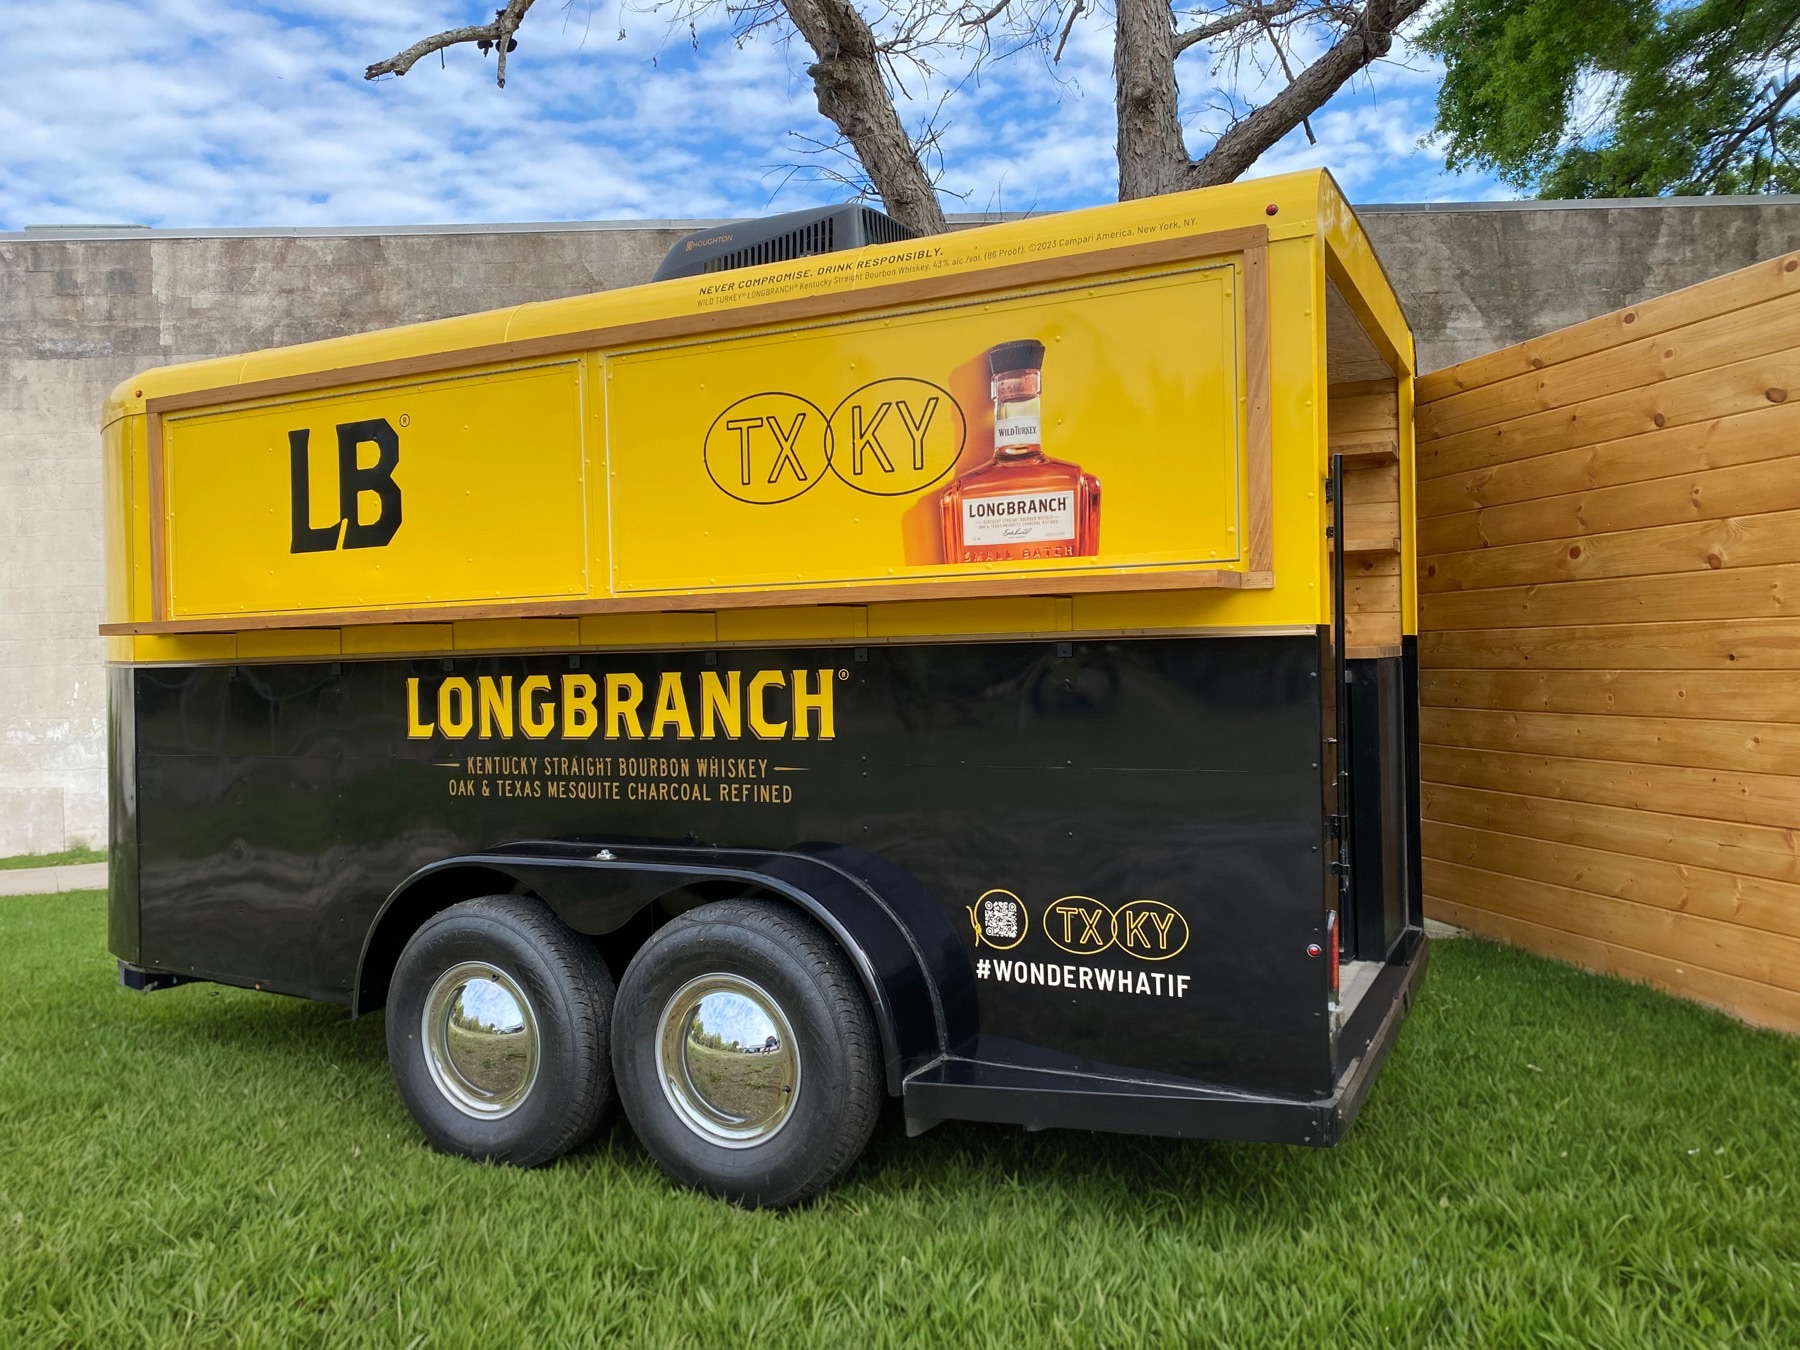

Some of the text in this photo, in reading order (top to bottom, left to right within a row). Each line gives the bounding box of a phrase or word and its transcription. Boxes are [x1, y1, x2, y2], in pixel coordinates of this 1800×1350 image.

[693, 234, 734, 248] HOUGHTON
[697, 298, 714, 307] WILD
[799, 277, 832, 290] Kentucky
[834, 273, 863, 285] Straight
[865, 268, 896, 280] Bourbon
[898, 264, 931, 275] Whiskey,
[933, 259, 950, 269] 43%
[984, 250, 997, 261] (86
[999, 245, 1025, 258] Proof).
[1028, 239, 1056, 252] ©2023
[1059, 234, 1094, 247] Campari
[1096, 229, 1135, 241] America,
[1137, 225, 1156, 234] New
[1159, 221, 1181, 231] York,
[1183, 217, 1198, 227] NY.
[699, 247, 943, 296] NEVER COMPROMISE. DRINK RESPONSIBLY.
[726, 397, 939, 485] TX KY
[969, 496, 1067, 518] LONGBRANCH
[964, 546, 1073, 563] SMALL BATCH
[467, 756, 768, 779] KENTUCKY STRAIGHT BOURBON WHISKEY
[449, 779, 793, 804] OAK & TEXAS MESQUITE CHARCOAL REFINED
[1056, 906, 1175, 949] TX KY
[976, 958, 1191, 998] #WONDERWHATIF
